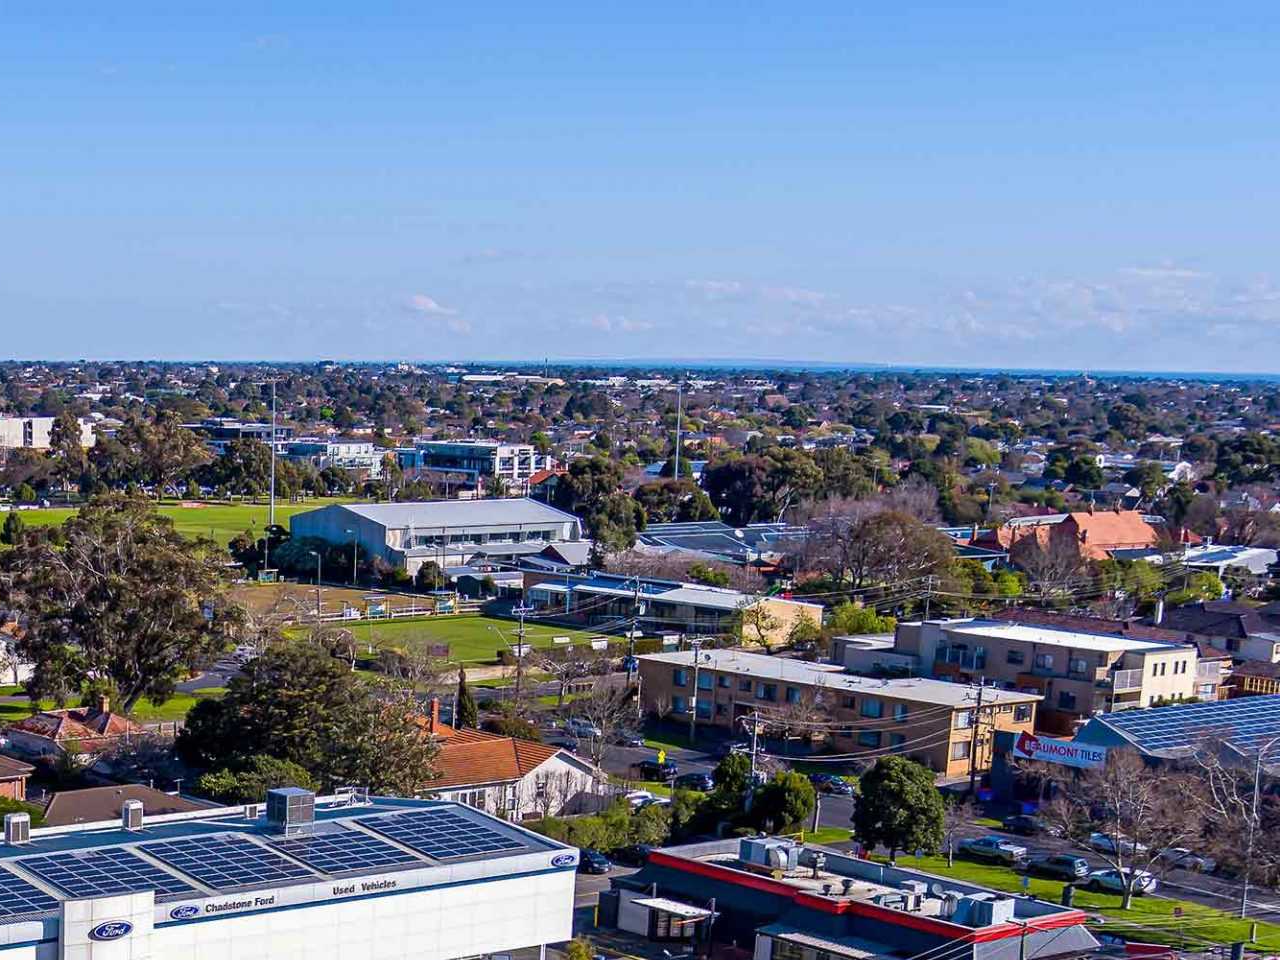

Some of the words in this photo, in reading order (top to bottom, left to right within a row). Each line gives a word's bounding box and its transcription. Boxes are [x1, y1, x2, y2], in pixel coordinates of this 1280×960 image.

[1024, 739, 1079, 758] BEAUMONT
[1081, 749, 1103, 761] TILES
[333, 884, 355, 895] Used
[361, 880, 397, 891] Vehicles
[206, 900, 252, 912] Chadstone
[254, 895, 275, 906] Ford
